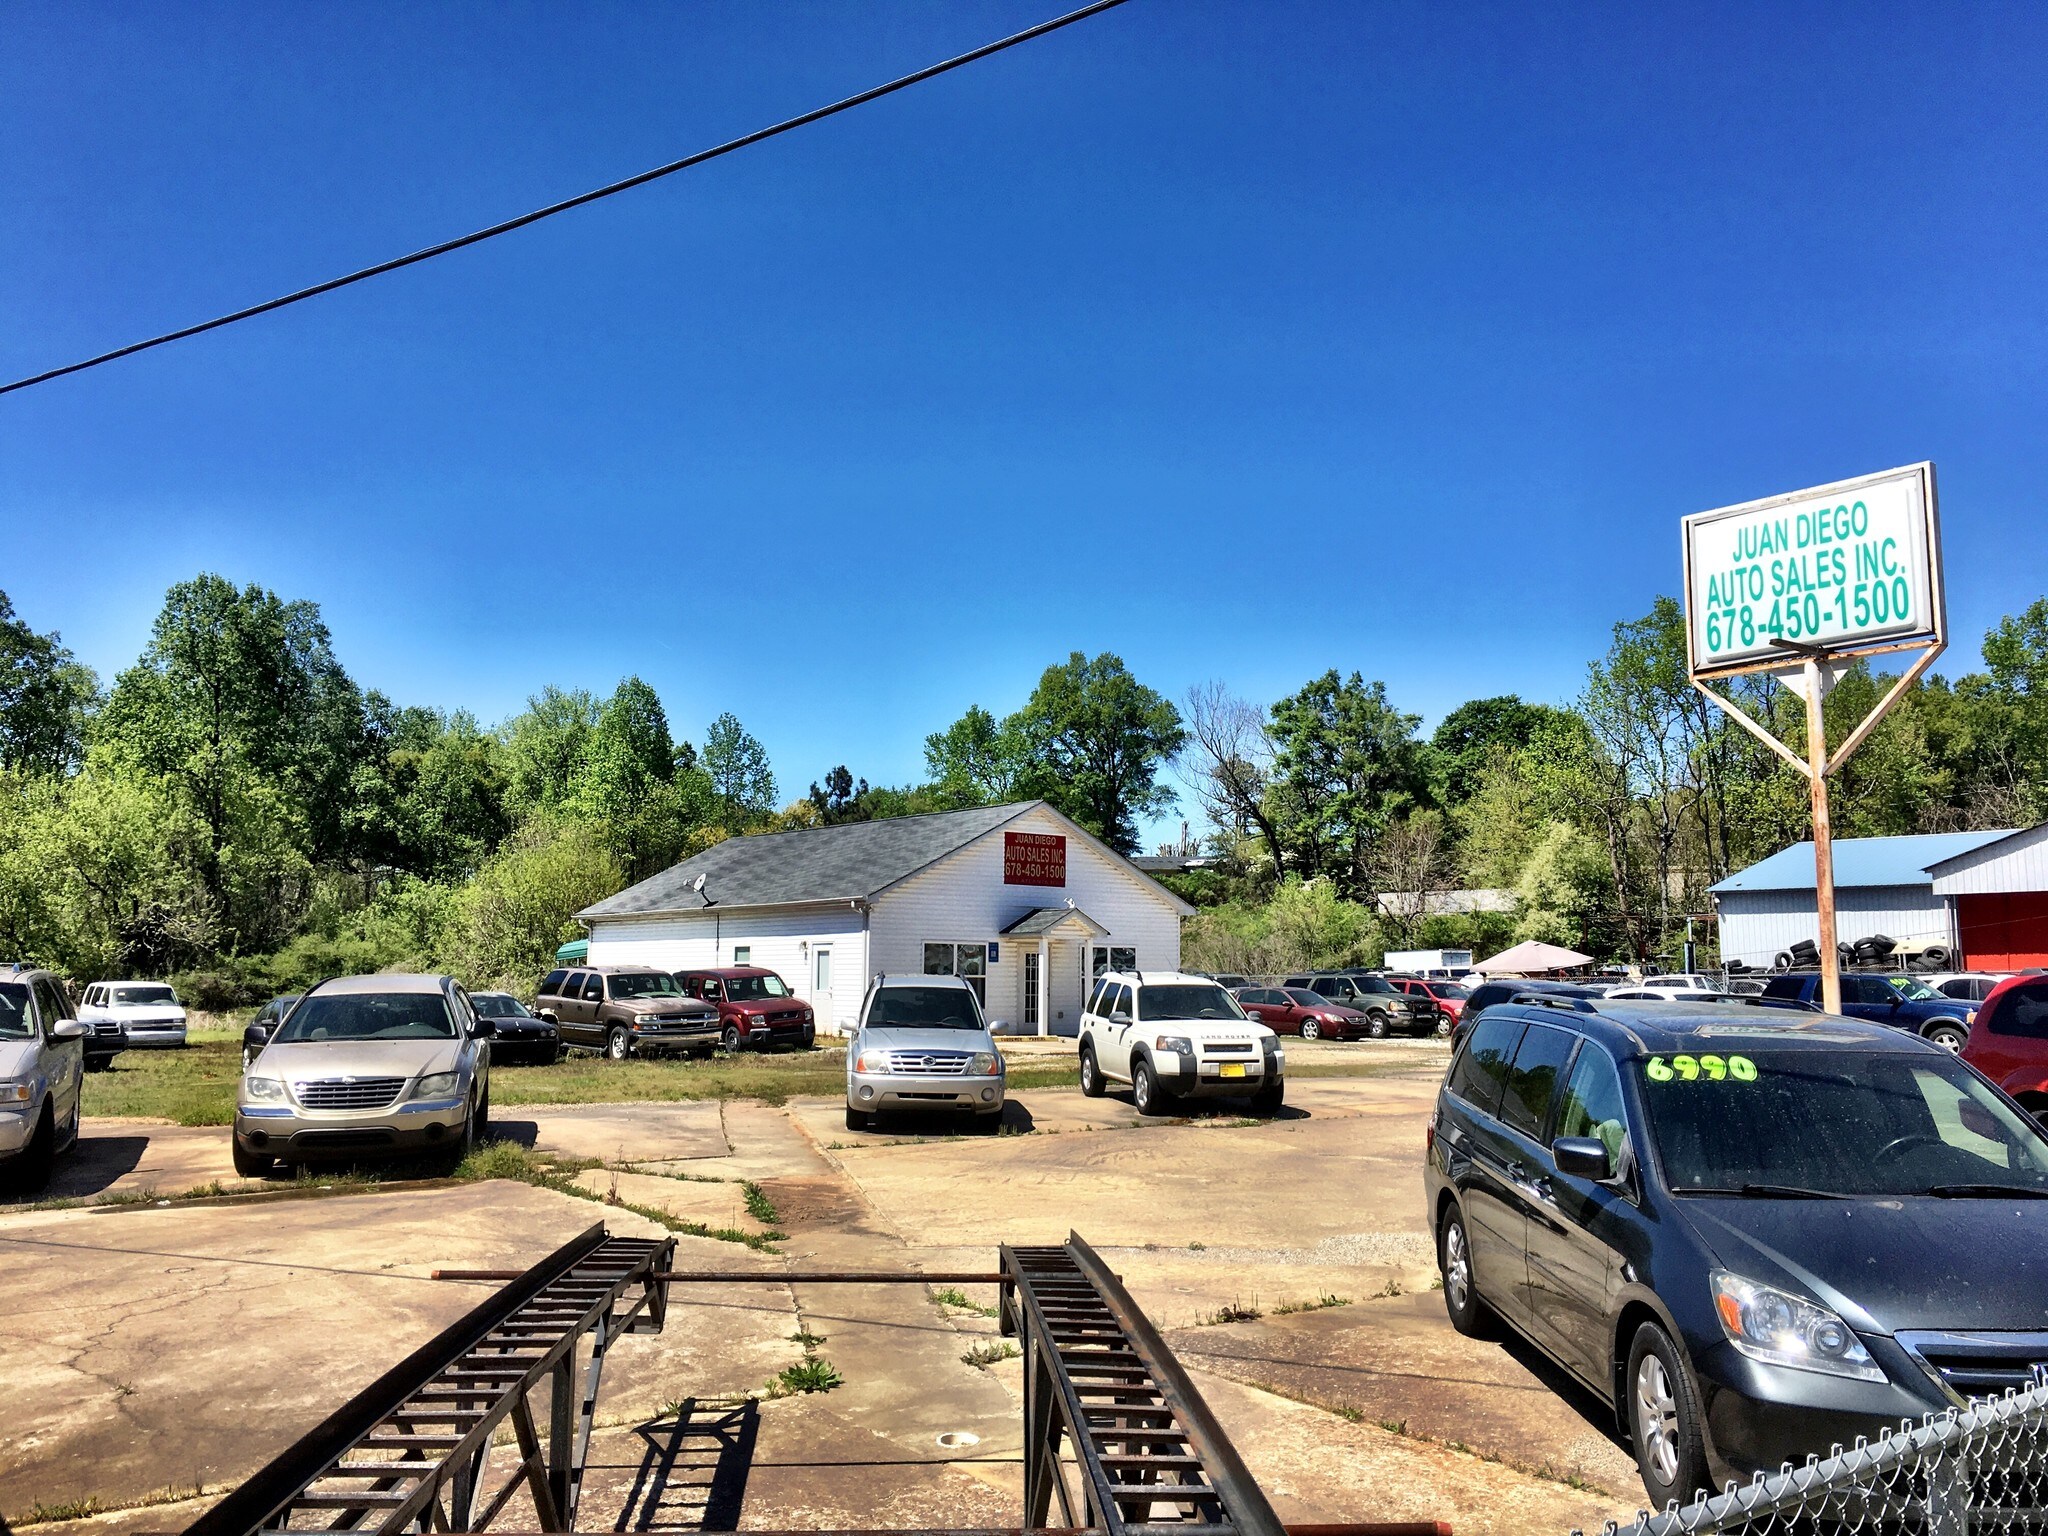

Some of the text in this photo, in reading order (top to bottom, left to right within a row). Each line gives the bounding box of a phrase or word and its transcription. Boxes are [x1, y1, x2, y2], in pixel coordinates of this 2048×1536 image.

[1732, 501, 1868, 562] JUAN DIEGO
[1707, 537, 1906, 610] AUTO SALES INC.
[1706, 576, 1909, 652] 678-450-1500
[1015, 835, 1057, 846] JUAN DIEGO
[1005, 846, 1026, 861] AUTO
[1026, 847, 1050, 863] SALES
[1005, 862, 1065, 879] 678-450-1500
[1647, 1055, 1758, 1082] 6990
